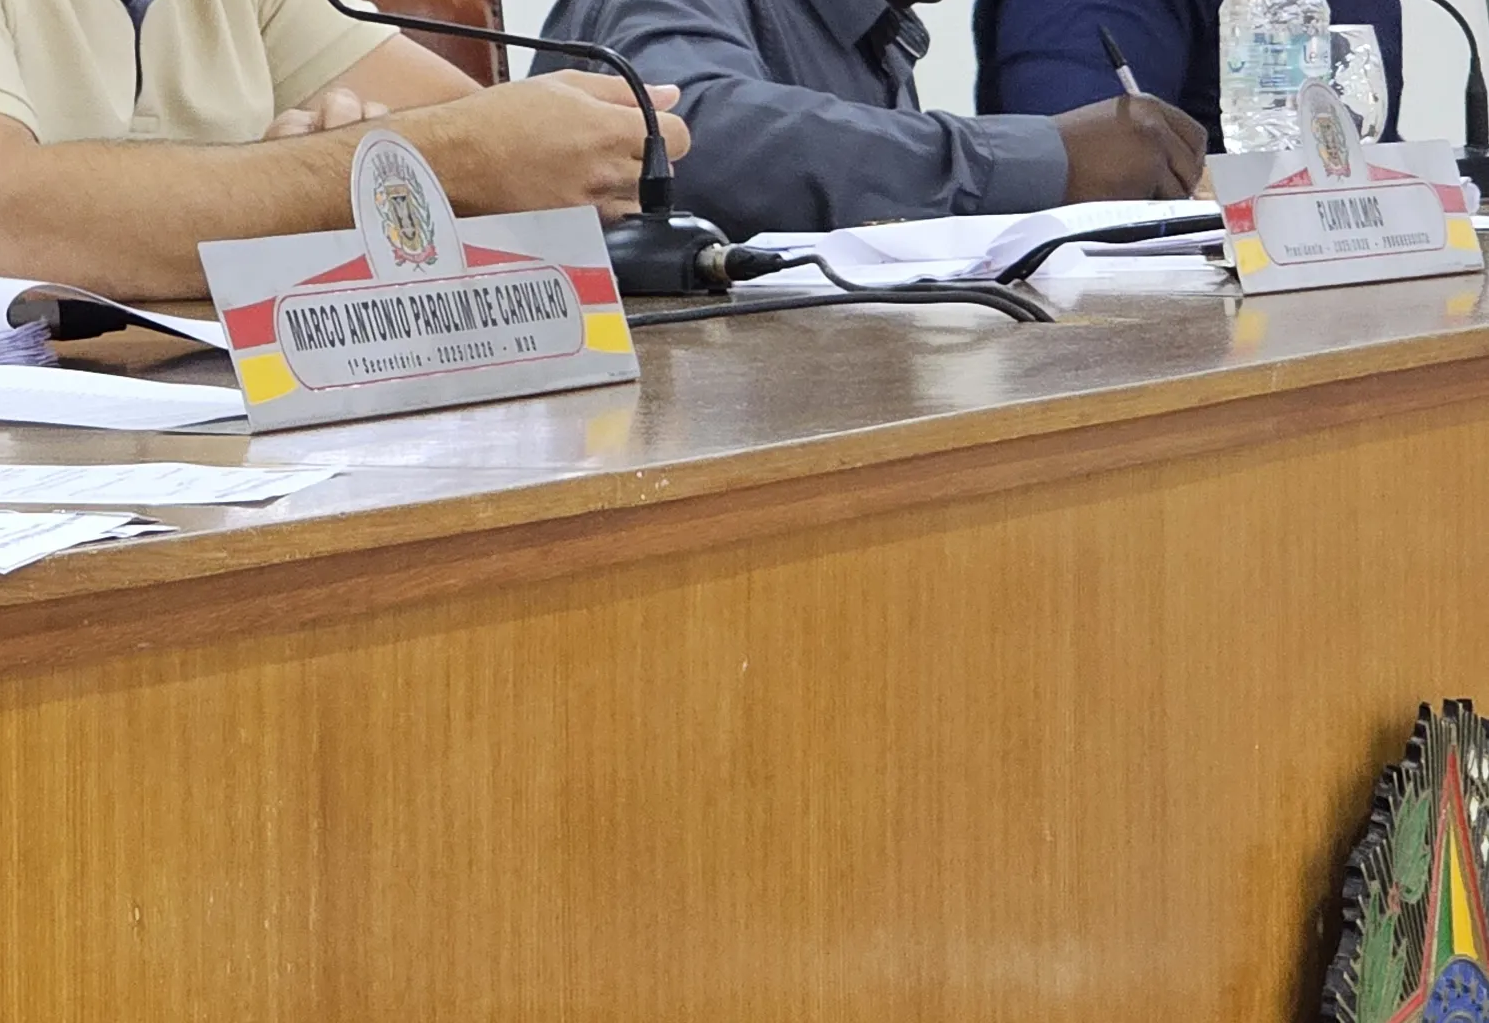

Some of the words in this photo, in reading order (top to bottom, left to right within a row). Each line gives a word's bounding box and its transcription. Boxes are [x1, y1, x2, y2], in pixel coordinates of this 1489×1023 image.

[285, 304, 346, 352] MARCO
[343, 296, 412, 346] ANTONIO
[408, 289, 478, 337] PAROLIM
[472, 287, 498, 329] DE
[494, 277, 569, 326] CARVALHO
[436, 340, 495, 365] 2025/2026
